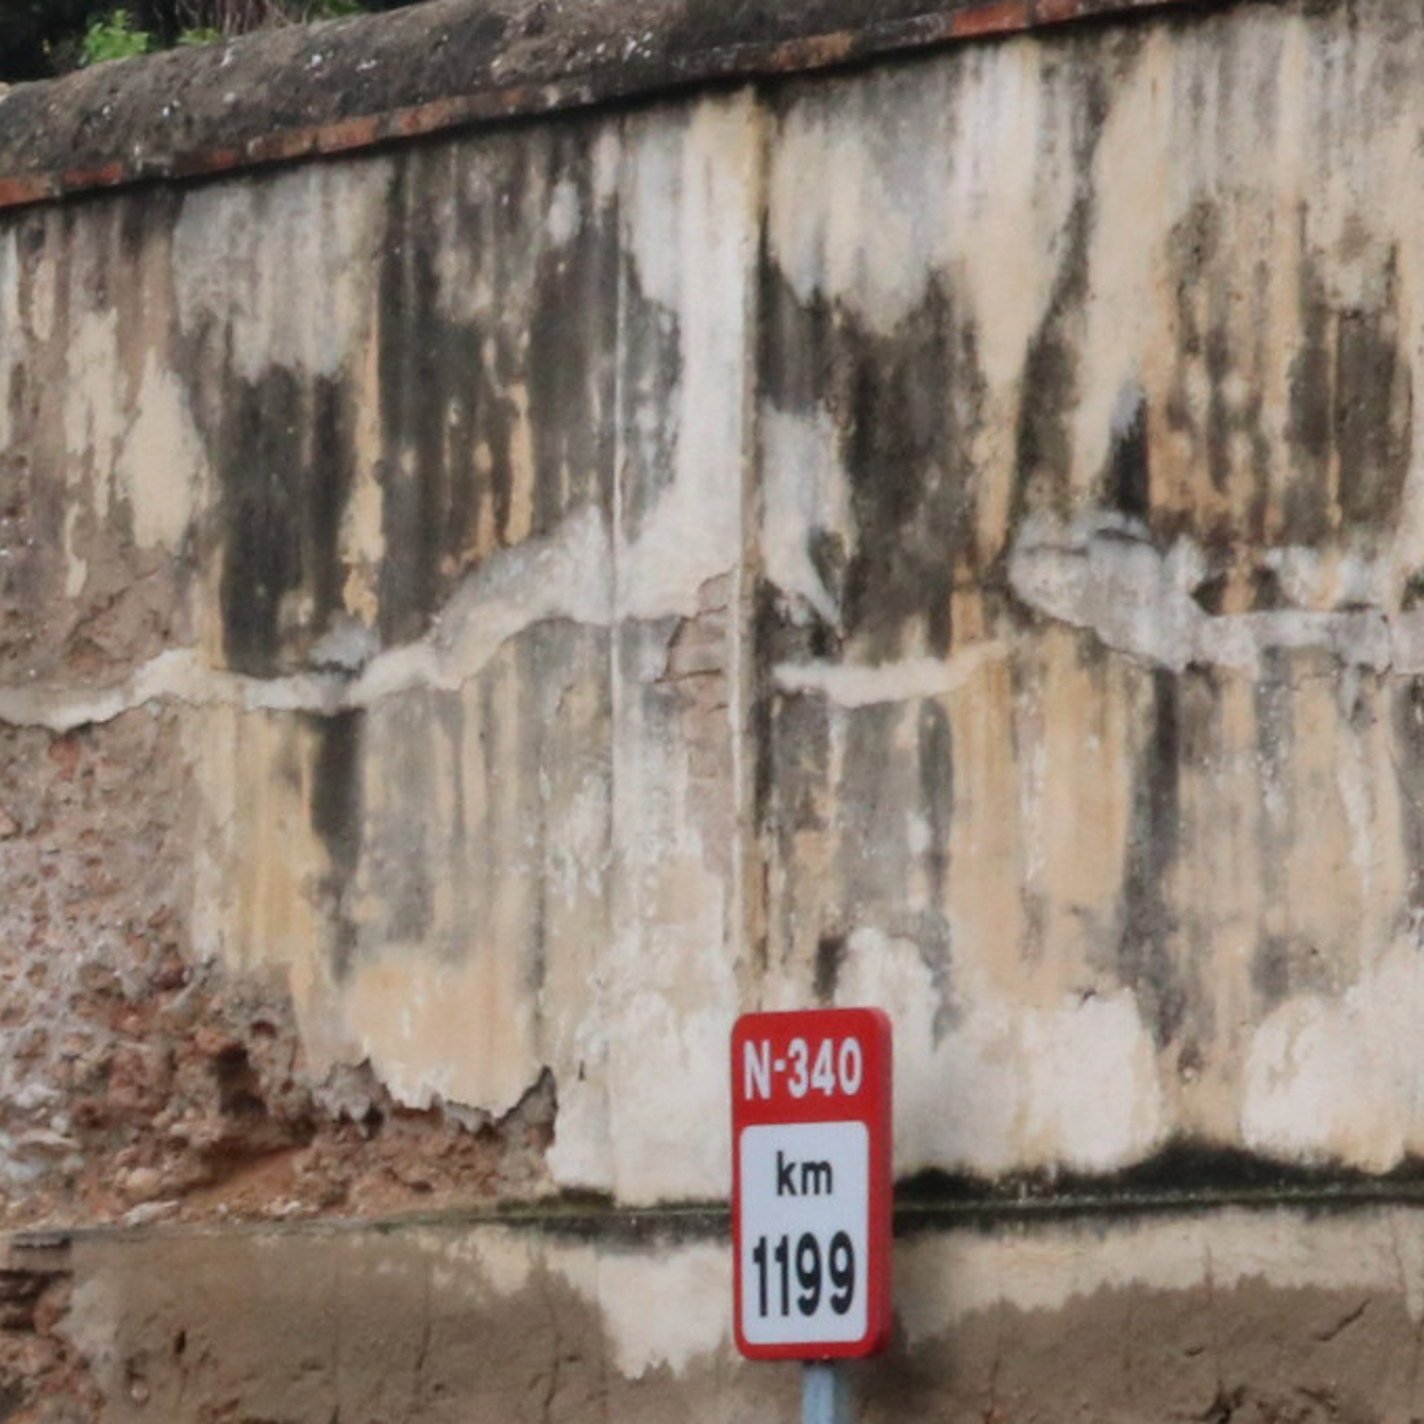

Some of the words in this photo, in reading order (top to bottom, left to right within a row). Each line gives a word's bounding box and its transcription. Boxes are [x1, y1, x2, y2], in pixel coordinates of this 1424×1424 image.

[743, 1037, 863, 1100] N-340
[776, 1150, 834, 1196] km
[753, 1230, 855, 1317] 1199
